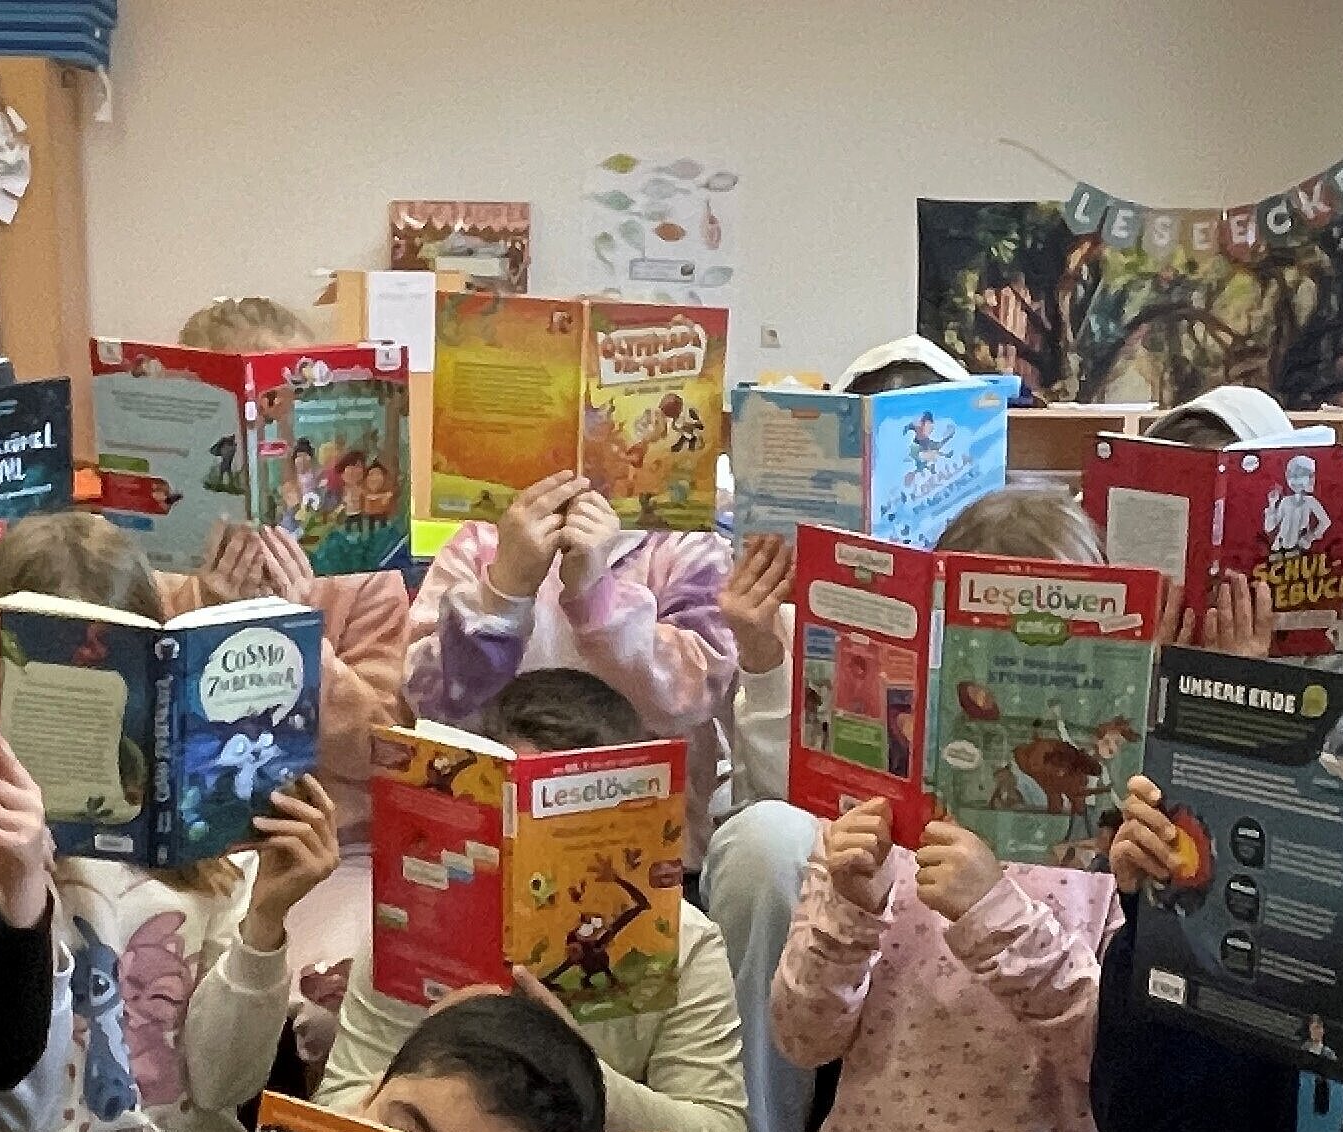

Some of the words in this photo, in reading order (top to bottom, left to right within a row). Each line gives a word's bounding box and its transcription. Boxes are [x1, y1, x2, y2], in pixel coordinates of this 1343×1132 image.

[968, 578, 1117, 614] Leselöwen
[1179, 676, 1245, 706] UNSERE
[1248, 686, 1297, 715] ERDE
[541, 775, 662, 810] Leselöwen
